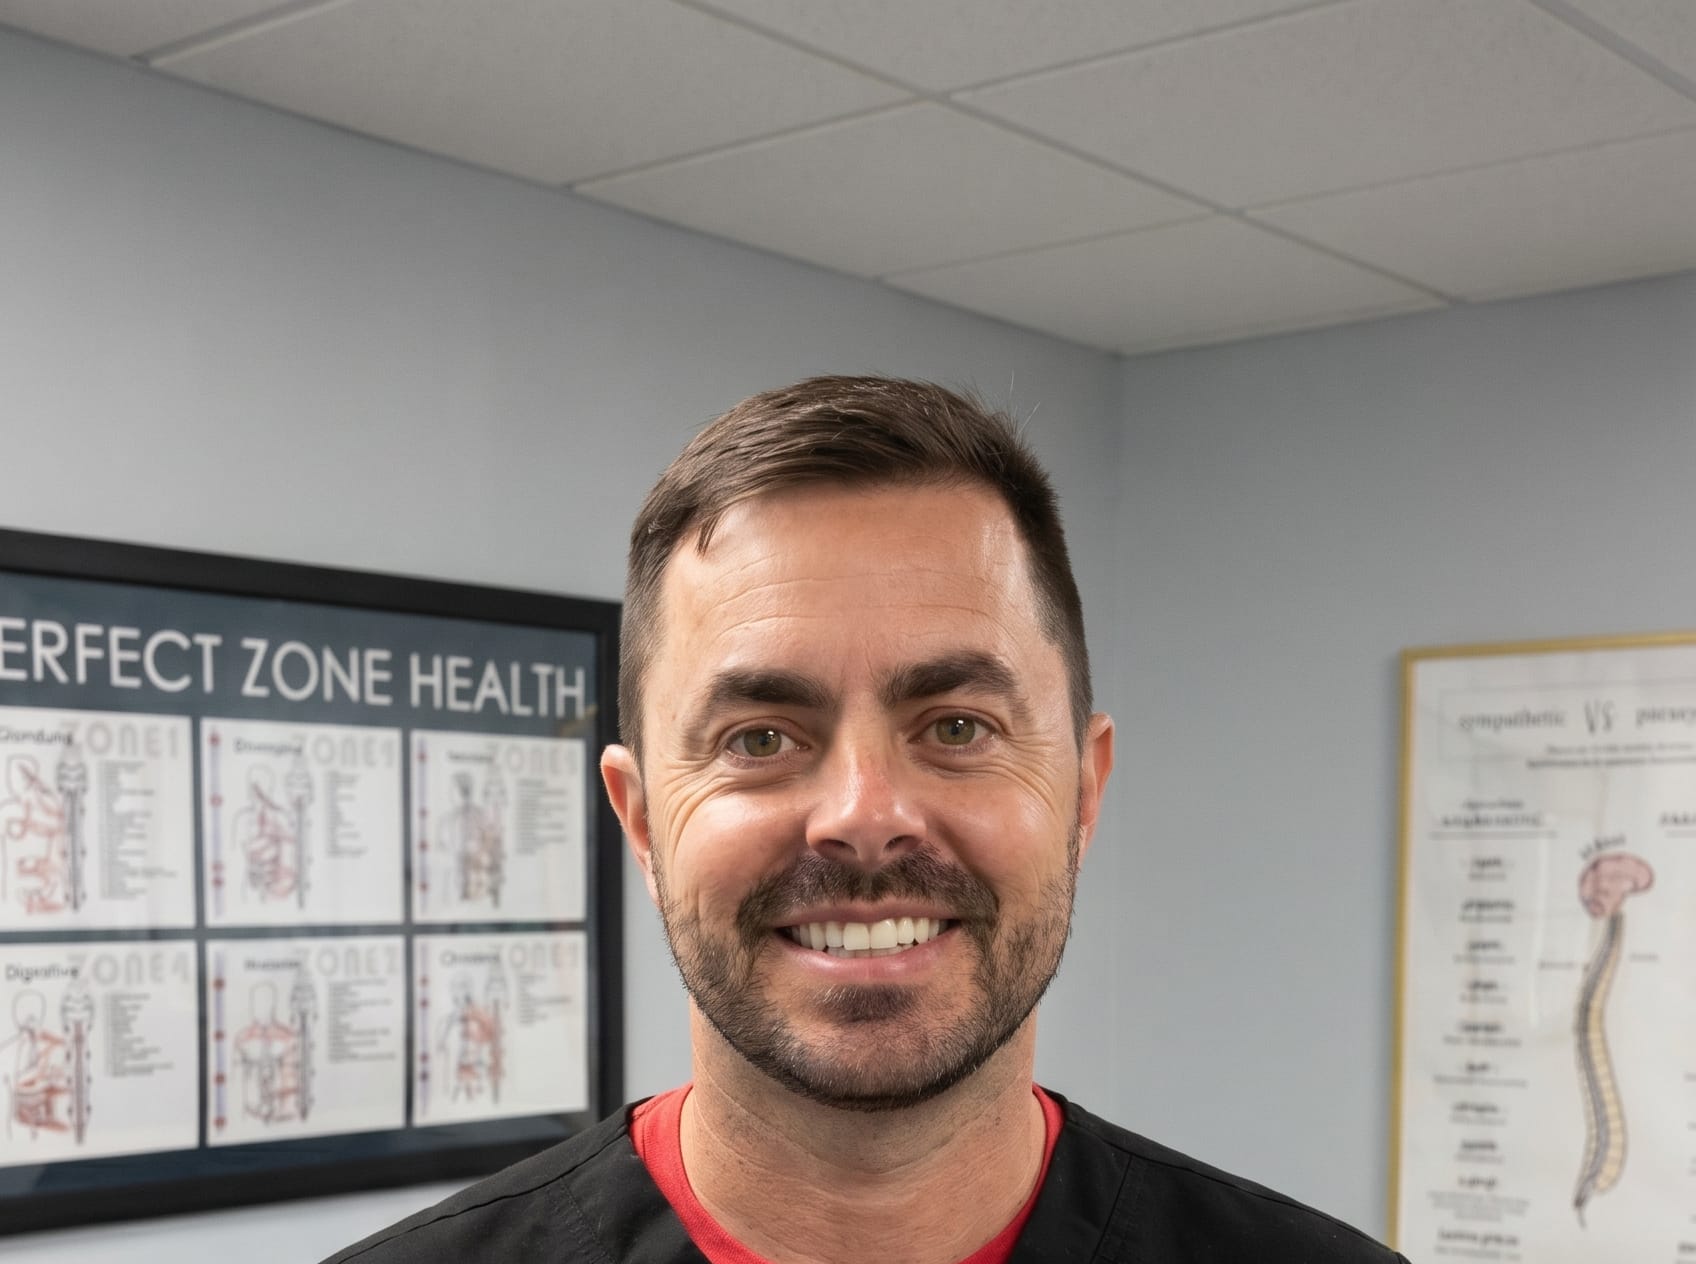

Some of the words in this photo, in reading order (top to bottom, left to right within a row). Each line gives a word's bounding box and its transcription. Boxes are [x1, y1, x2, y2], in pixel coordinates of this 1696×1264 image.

[0, 616, 223, 694] ERFECT
[241, 637, 393, 705] ZONE
[409, 652, 586, 719] HEALTH
